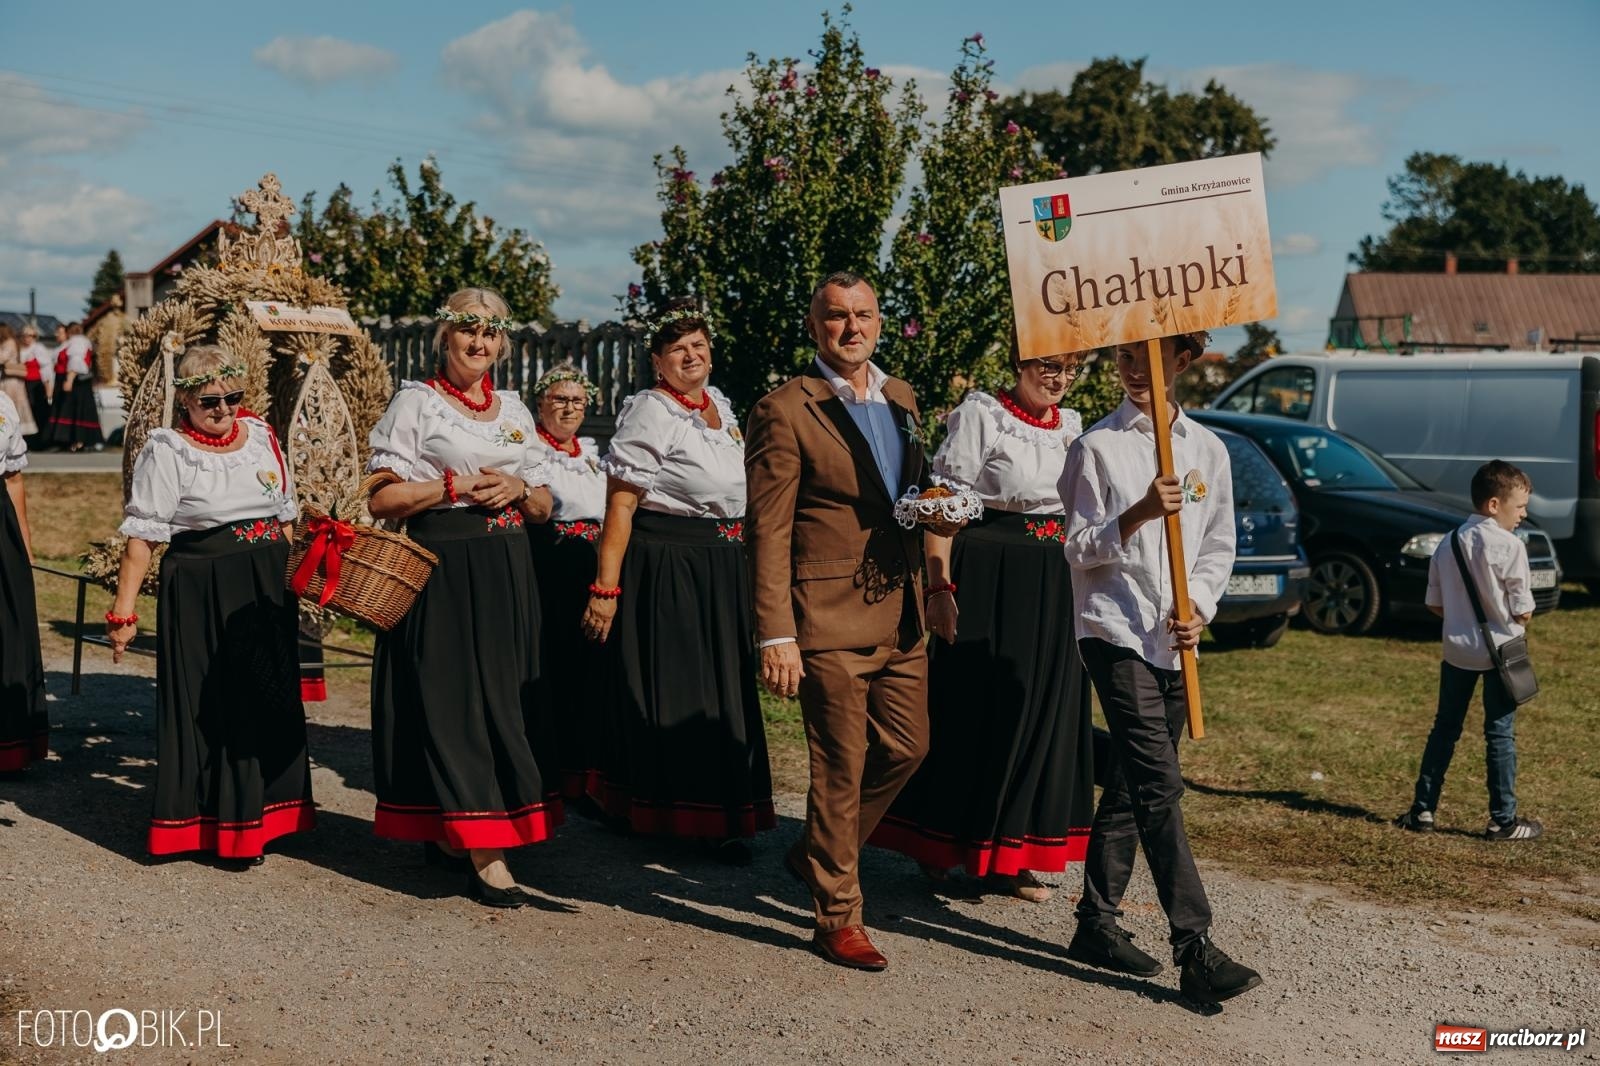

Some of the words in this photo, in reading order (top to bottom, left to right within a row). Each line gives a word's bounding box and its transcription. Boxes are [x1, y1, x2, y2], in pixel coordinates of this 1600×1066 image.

[1160, 184, 1190, 197] Gmina
[1191, 177, 1252, 195] Krzyżanowice
[1041, 243, 1249, 316] Chałupki
